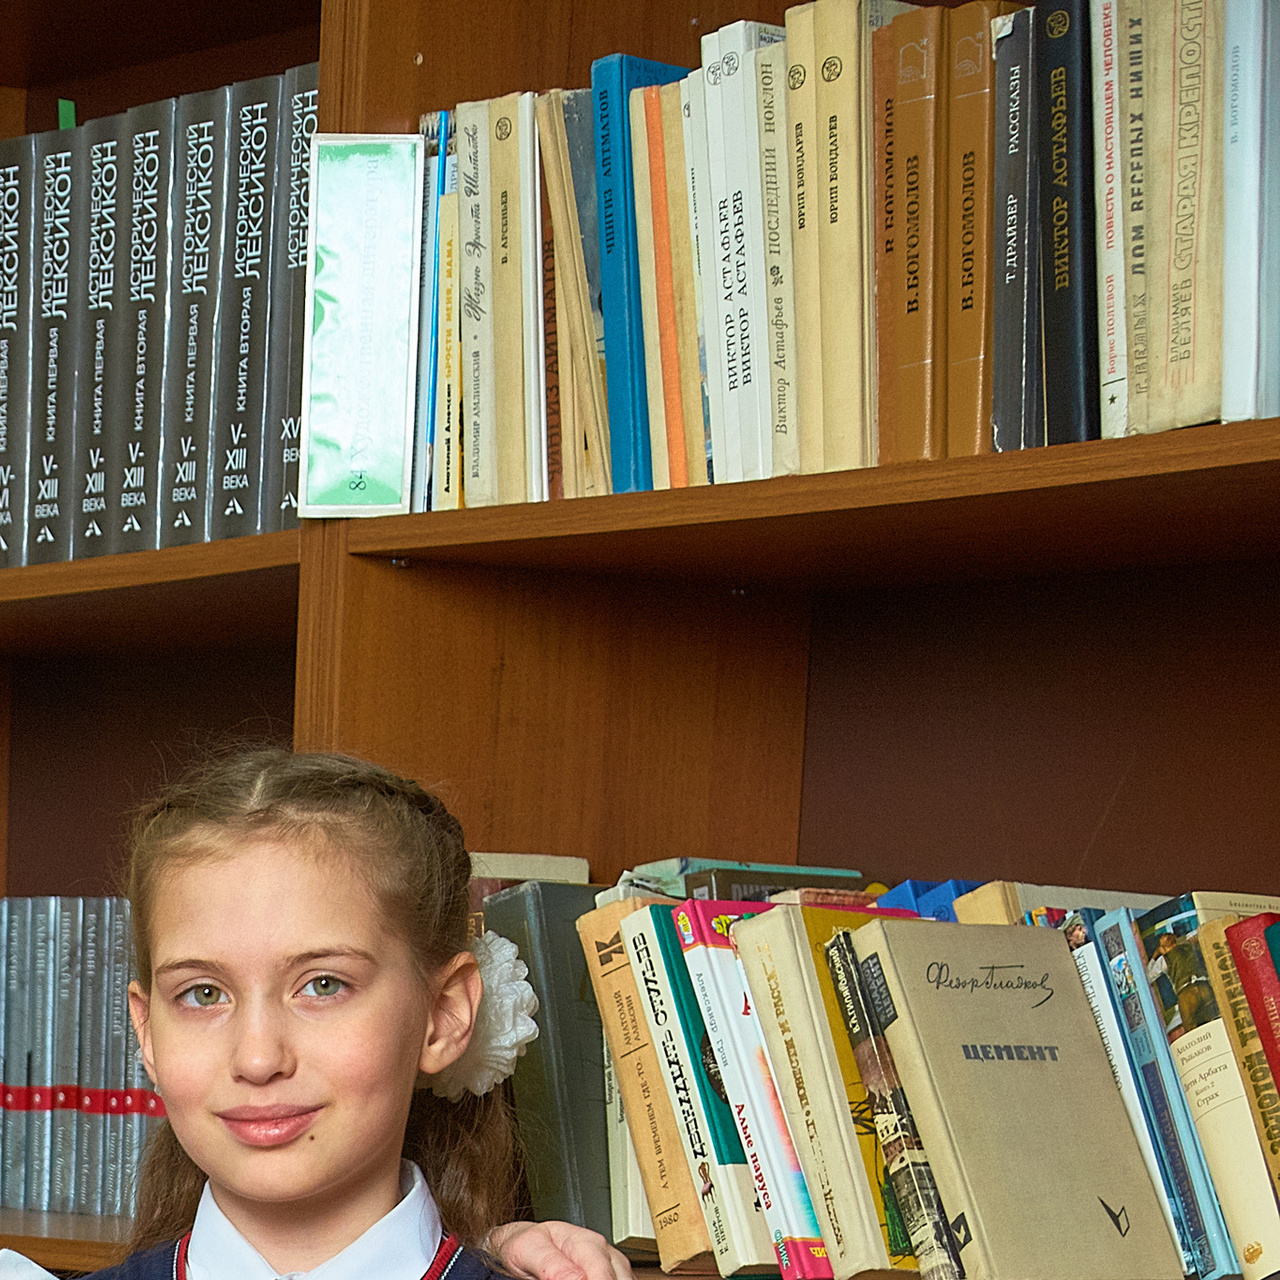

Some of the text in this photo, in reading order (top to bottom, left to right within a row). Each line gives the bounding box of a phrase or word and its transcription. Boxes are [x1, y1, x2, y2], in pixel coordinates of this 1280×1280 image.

[1008, 65, 1020, 154] РАССКАЗЫ
[1102, 2, 1115, 249] ПОВЕСТЬ О НАСТОЯЩЕМ ЧЕЛОВЕКЕ
[182, 124, 198, 294] ИСТОРИЧЕСКИЙ
[192, 121, 214, 295] ЛЕКСИКОН
[235, 106, 252, 278] ИСТОРИЧЕСКИЙ
[246, 103, 268, 279] ЛЕКСИКОН
[1051, 66, 1069, 291] ВИКТОР АСТАФЬЕВ
[1174, 154, 1198, 270] СТАРАЯ
[733, 190, 751, 385] ВИКТОР АСТАФЬЕВ
[761, 62, 790, 435] Виктор Астафьев ПОСЛЕДНИЙ ПОКЛОН
[237, 287, 251, 412] КНИГА ВТОРАЯ
[1180, 279, 1191, 360] БЕЛЯЕВ
[223, 475, 249, 490] ВЕКА
[225, 448, 247, 471] XIII
[349, 468, 366, 490] 84
[633, 932, 668, 1027] СТУЛЬЕВ
[962, 1044, 1059, 1062] ЦЕМЕНТ
[1196, 1091, 1220, 1108] Страх
[1198, 1063, 1228, 1081] Арбата
[735, 1103, 773, 1211] Алые паруса
[658, 1212, 679, 1230] 1980
